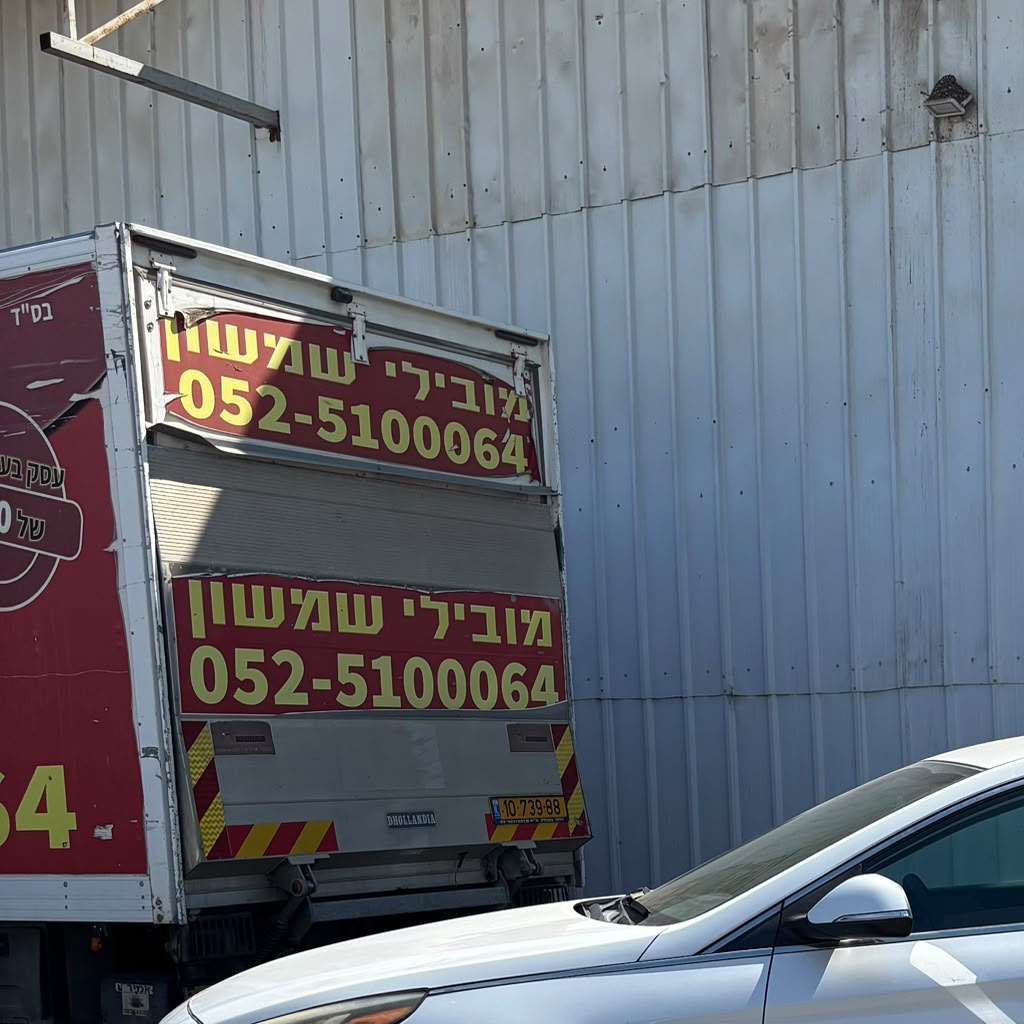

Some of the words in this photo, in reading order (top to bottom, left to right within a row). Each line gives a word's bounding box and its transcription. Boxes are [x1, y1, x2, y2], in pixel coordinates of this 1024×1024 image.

[10, 302, 54, 326] בס"ד
[164, 318, 357, 386] שמשון
[178, 368, 529, 474] 052-5100064
[385, 360, 531, 423] מובילי
[26, 460, 65, 488] עסק
[16, 508, 46, 541] של
[188, 579, 384, 639] שמשון
[403, 594, 553, 648] מובילי
[189, 644, 559, 711] 052-5100064
[0, 764, 77, 849] 4
